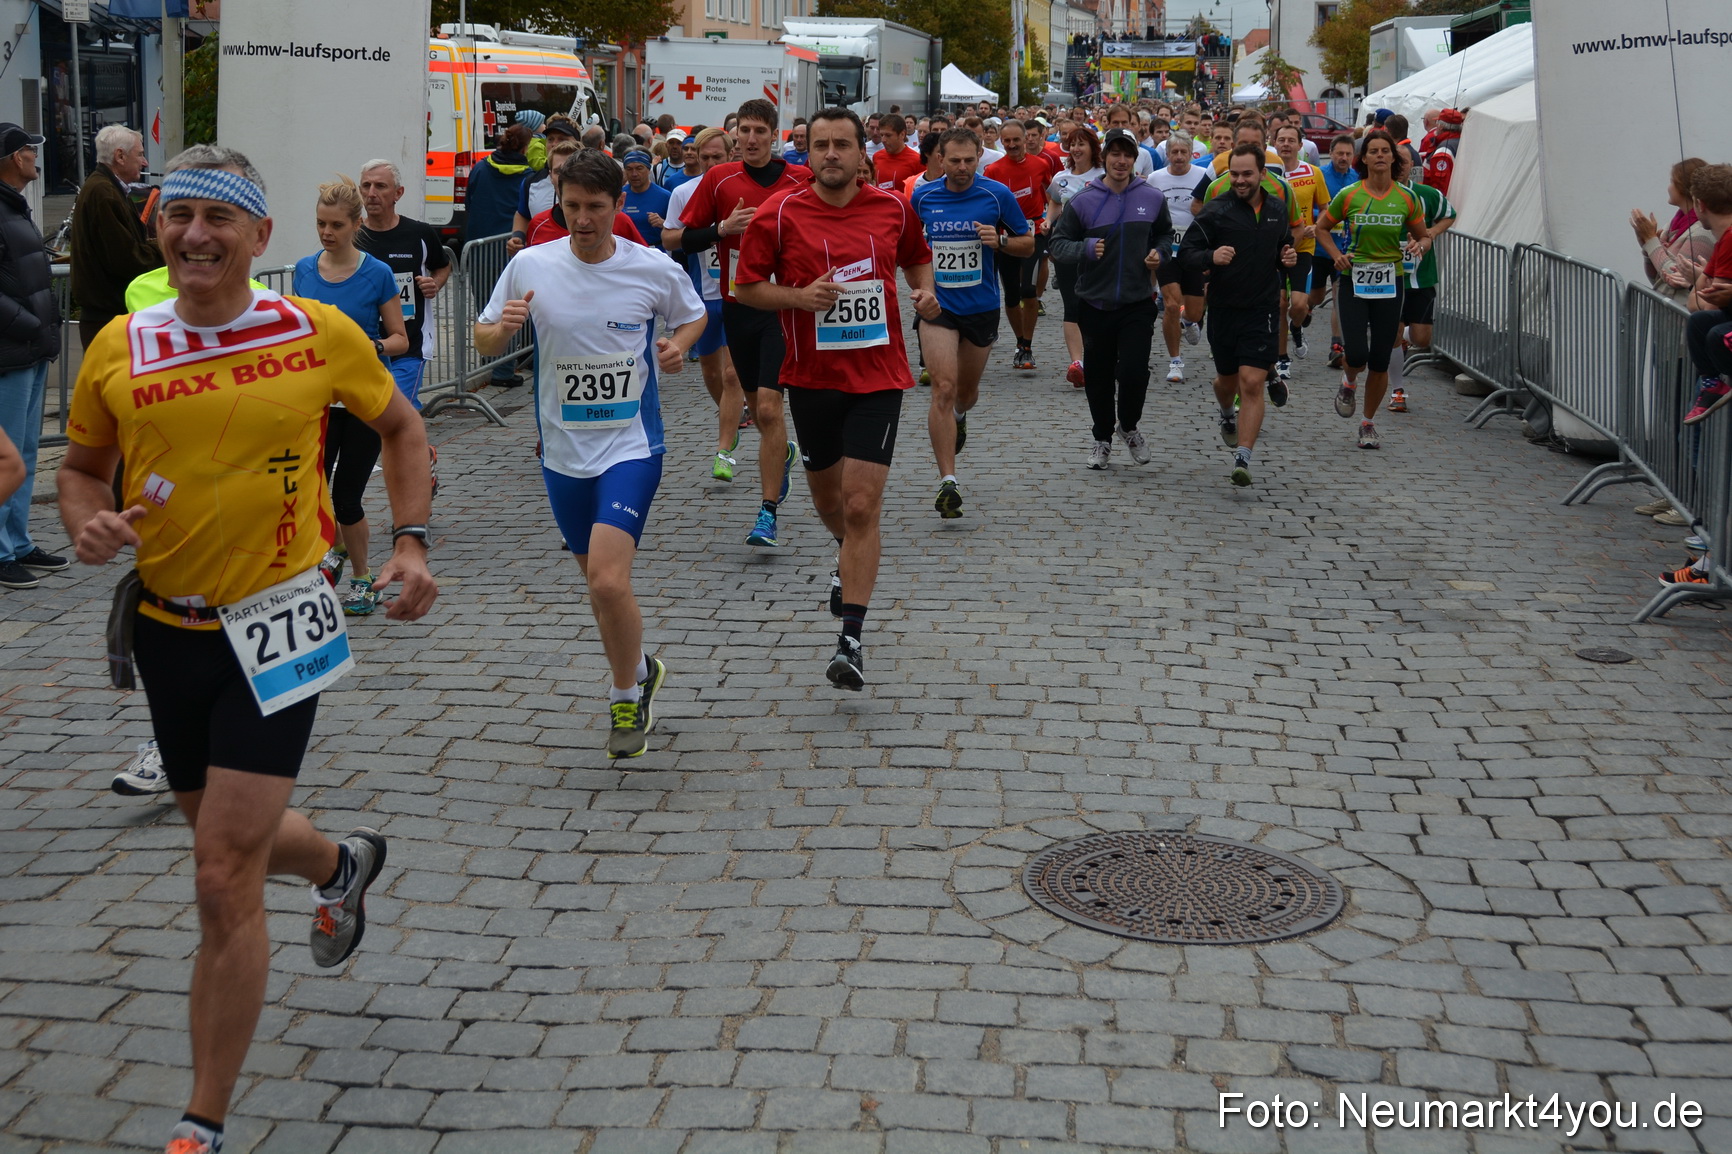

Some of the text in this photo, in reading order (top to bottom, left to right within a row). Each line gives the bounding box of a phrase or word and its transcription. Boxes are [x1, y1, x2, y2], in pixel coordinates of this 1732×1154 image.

[3, 41, 12, 61] 3
[222, 41, 391, 62] www.bmw-laufsport.de
[429, 50, 438, 60] G
[1130, 61, 1163, 69] START
[706, 76, 751, 85] Bayerisches
[705, 85, 727, 93] Rotes
[705, 94, 727, 102] Kreuz
[1293, 179, 1316, 188] BÖGL
[1354, 213, 1403, 226] BOCK
[937, 251, 978, 270] 2213
[843, 265, 862, 277] DEHN
[1357, 269, 1390, 284] 2791
[823, 296, 881, 324] 2568
[841, 328, 865, 339] Adolf
[556, 361, 624, 371] PARTL Neumarkt
[131, 347, 326, 410] MAX BÖGL
[564, 370, 632, 401] 2397
[586, 407, 615, 419] Peter
[623, 505, 639, 518] JAKO
[225, 577, 322, 626] PARTL Neumarkt
[246, 592, 338, 666] 2739
[294, 653, 331, 681] Peter
